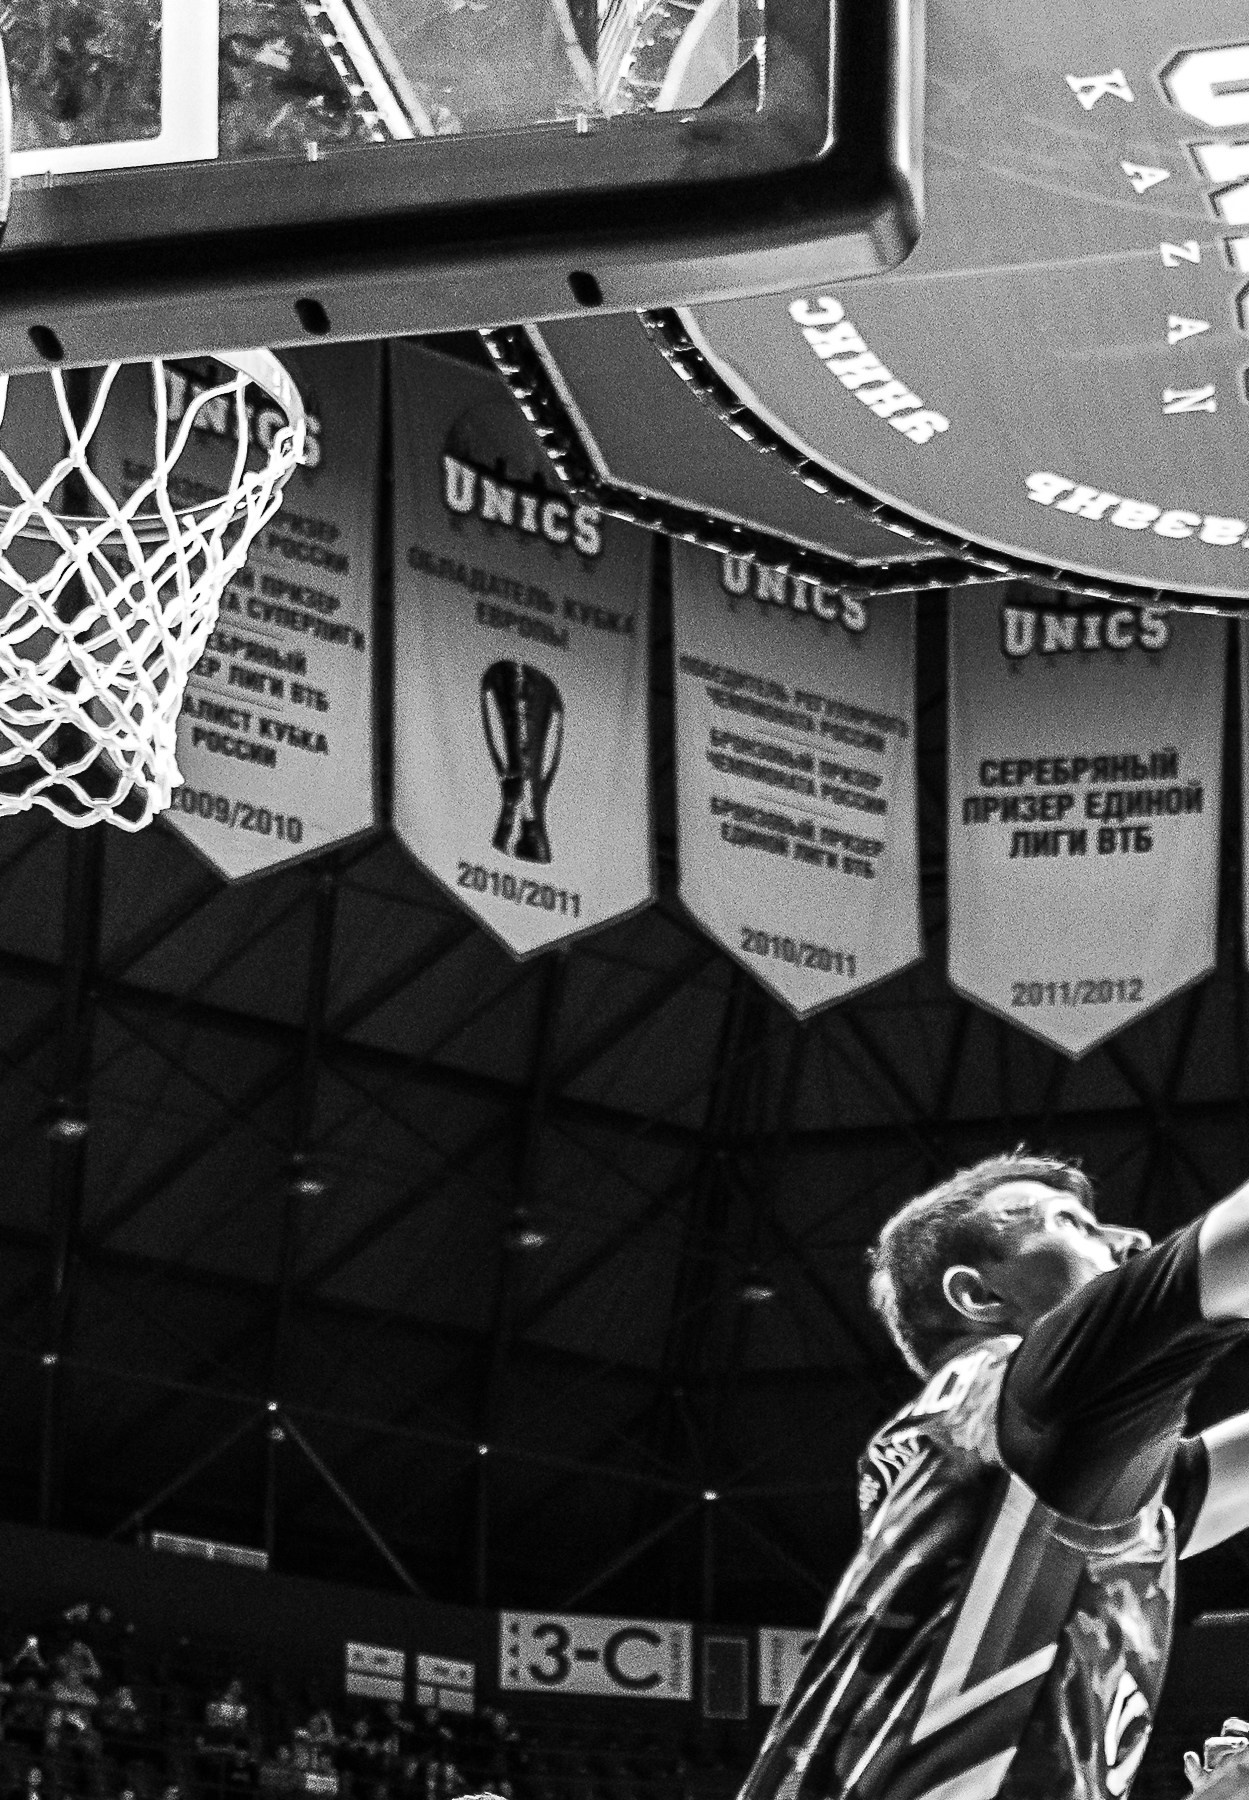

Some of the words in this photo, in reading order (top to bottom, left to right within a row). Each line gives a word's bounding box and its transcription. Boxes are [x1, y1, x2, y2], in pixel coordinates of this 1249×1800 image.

[443, 454, 603, 556] UNICS
[721, 551, 867, 632] UNICS
[1003, 606, 1169, 657] UNICS
[183, 693, 253, 733] АЛИСТ
[258, 716, 330, 756] КУБКА
[191, 725, 278, 769] РОССИИ
[978, 745, 1179, 788] СЕРЕБРЯНЫЙ
[962, 793, 1075, 826] ПРИЗЕР
[1084, 779, 1204, 824] ЕДИНОЙ
[1009, 828, 1088, 859] ЛИГИ
[1096, 825, 1154, 856] ВТБ
[456, 858, 582, 919] 2010/2011
[740, 926, 857, 979] 2010/2011
[1010, 976, 1146, 1010] 2011/2012
